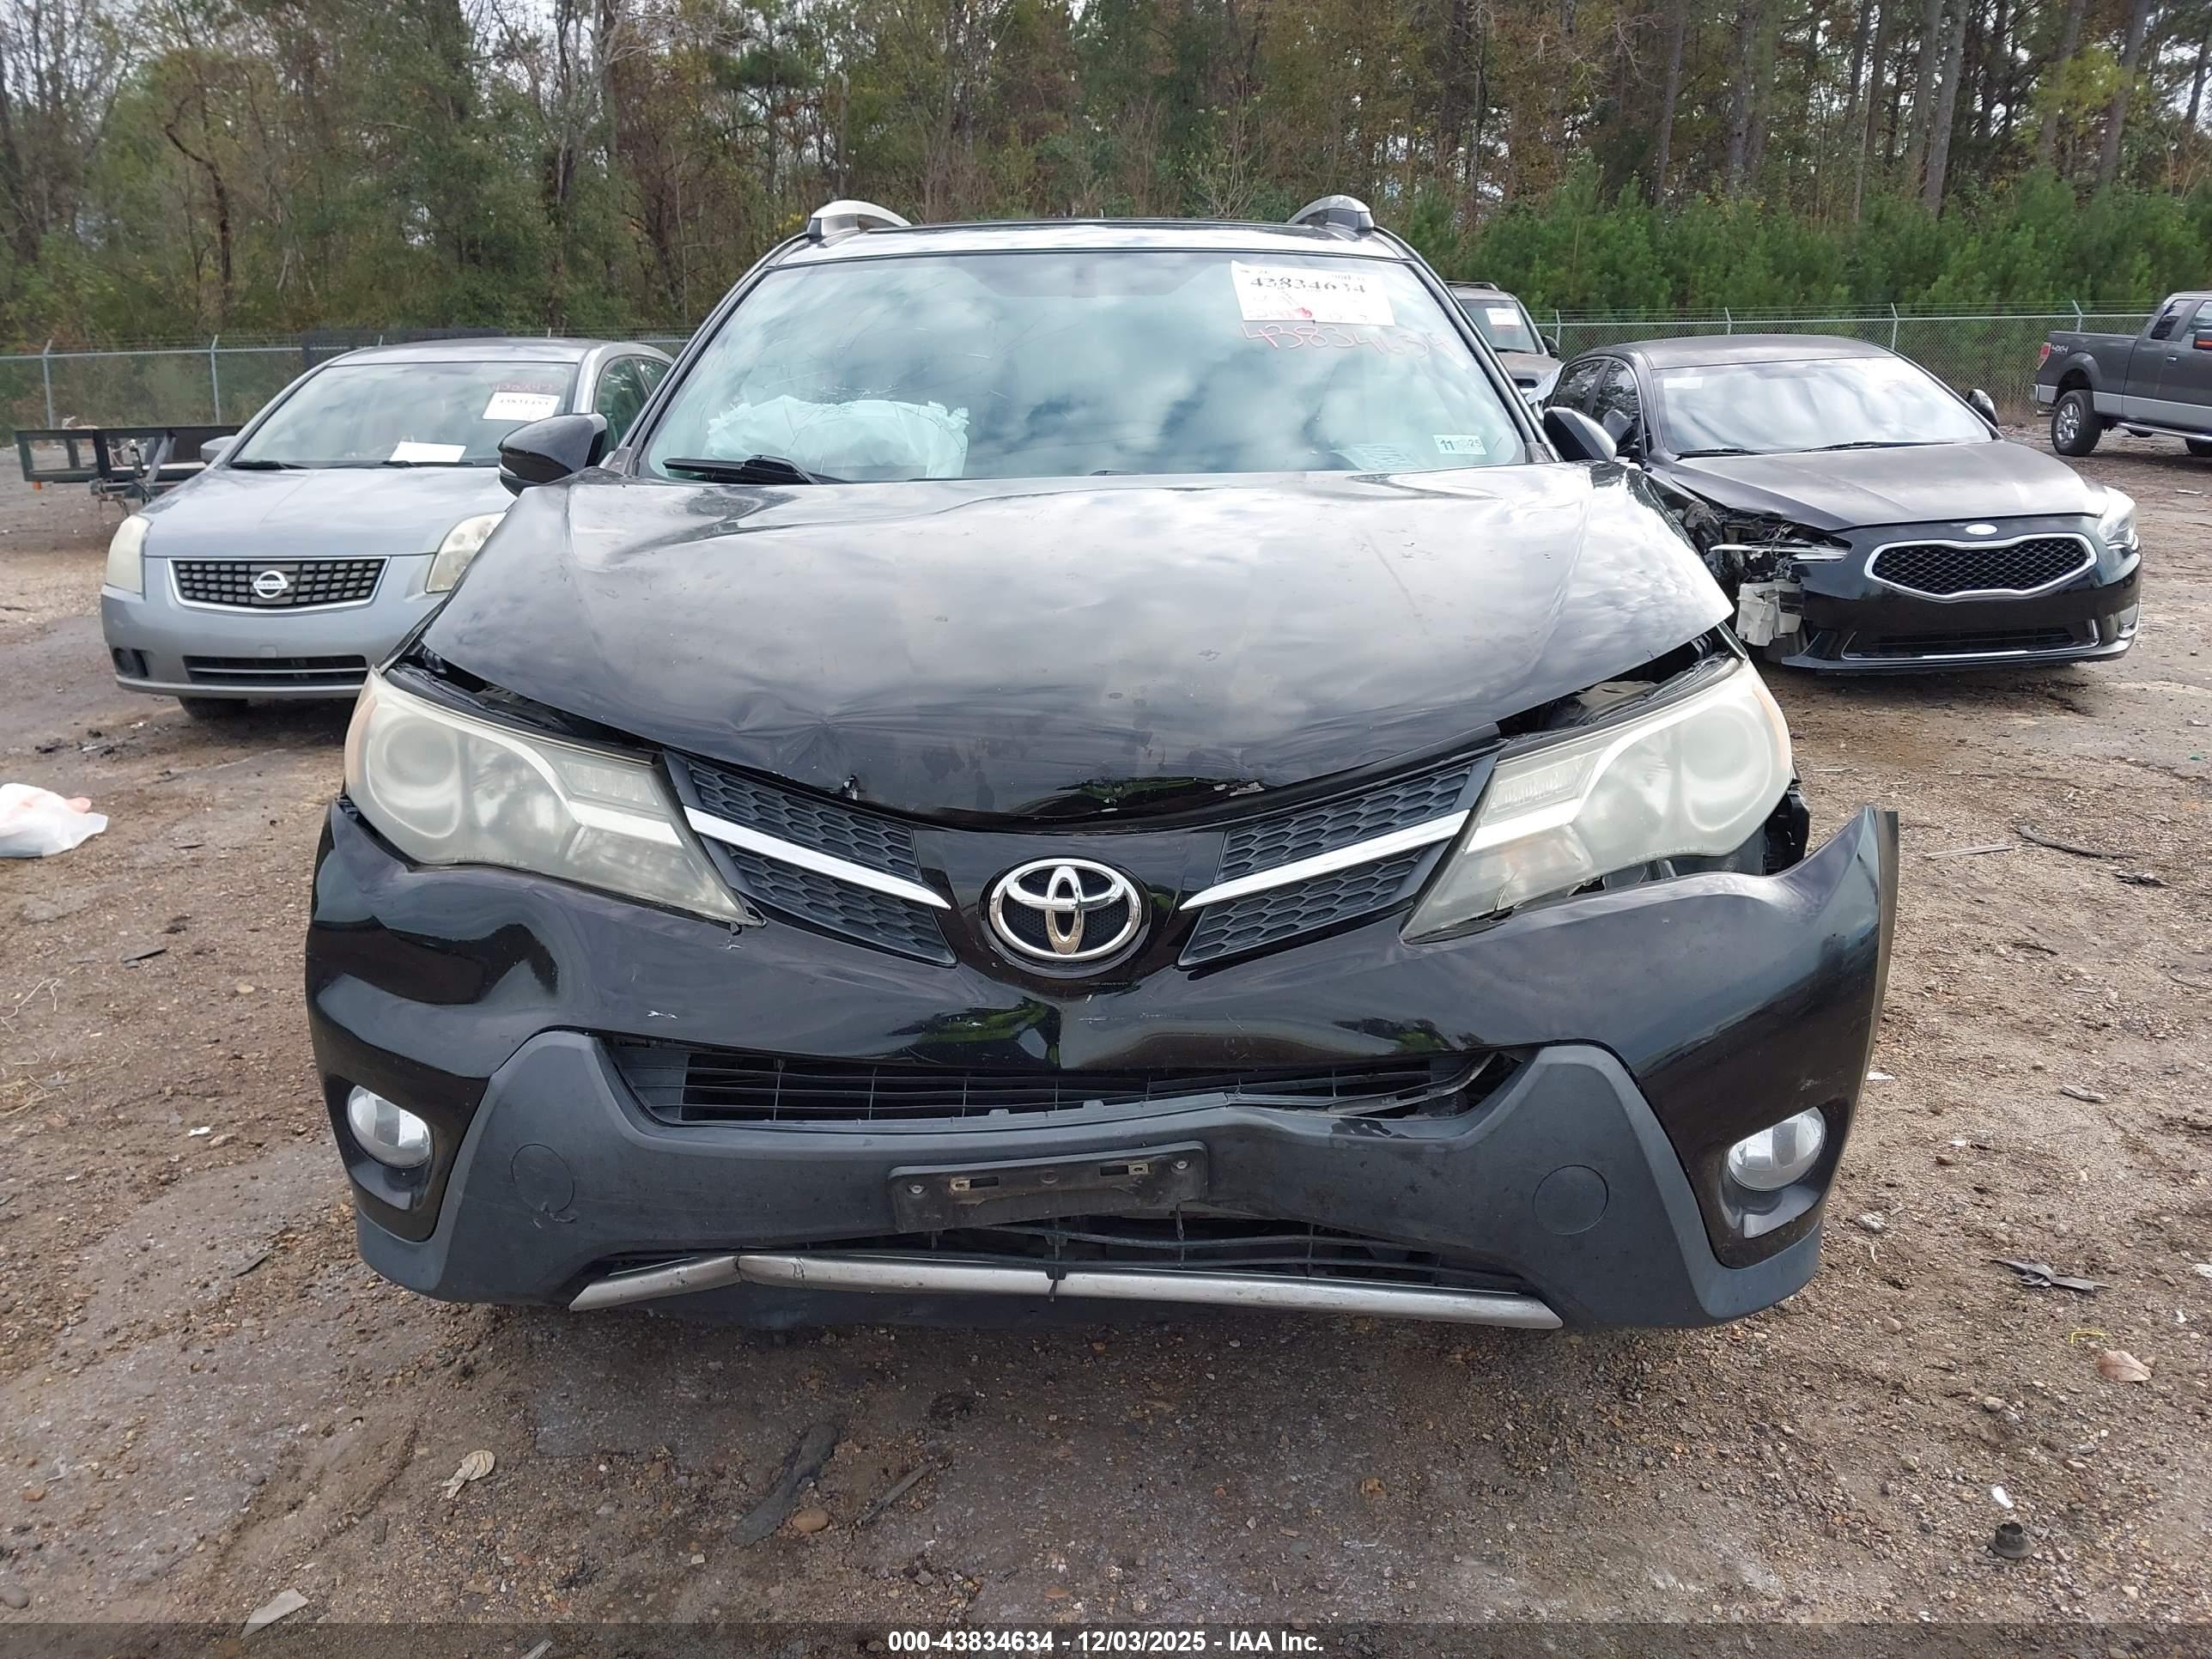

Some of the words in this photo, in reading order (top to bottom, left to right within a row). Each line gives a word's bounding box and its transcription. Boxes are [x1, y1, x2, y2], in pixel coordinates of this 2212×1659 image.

[1249, 276, 1367, 295] 43834634
[1242, 324, 1458, 360] 43834634
[1441, 439, 1456, 451] 11
[1468, 439, 1483, 447] 25
